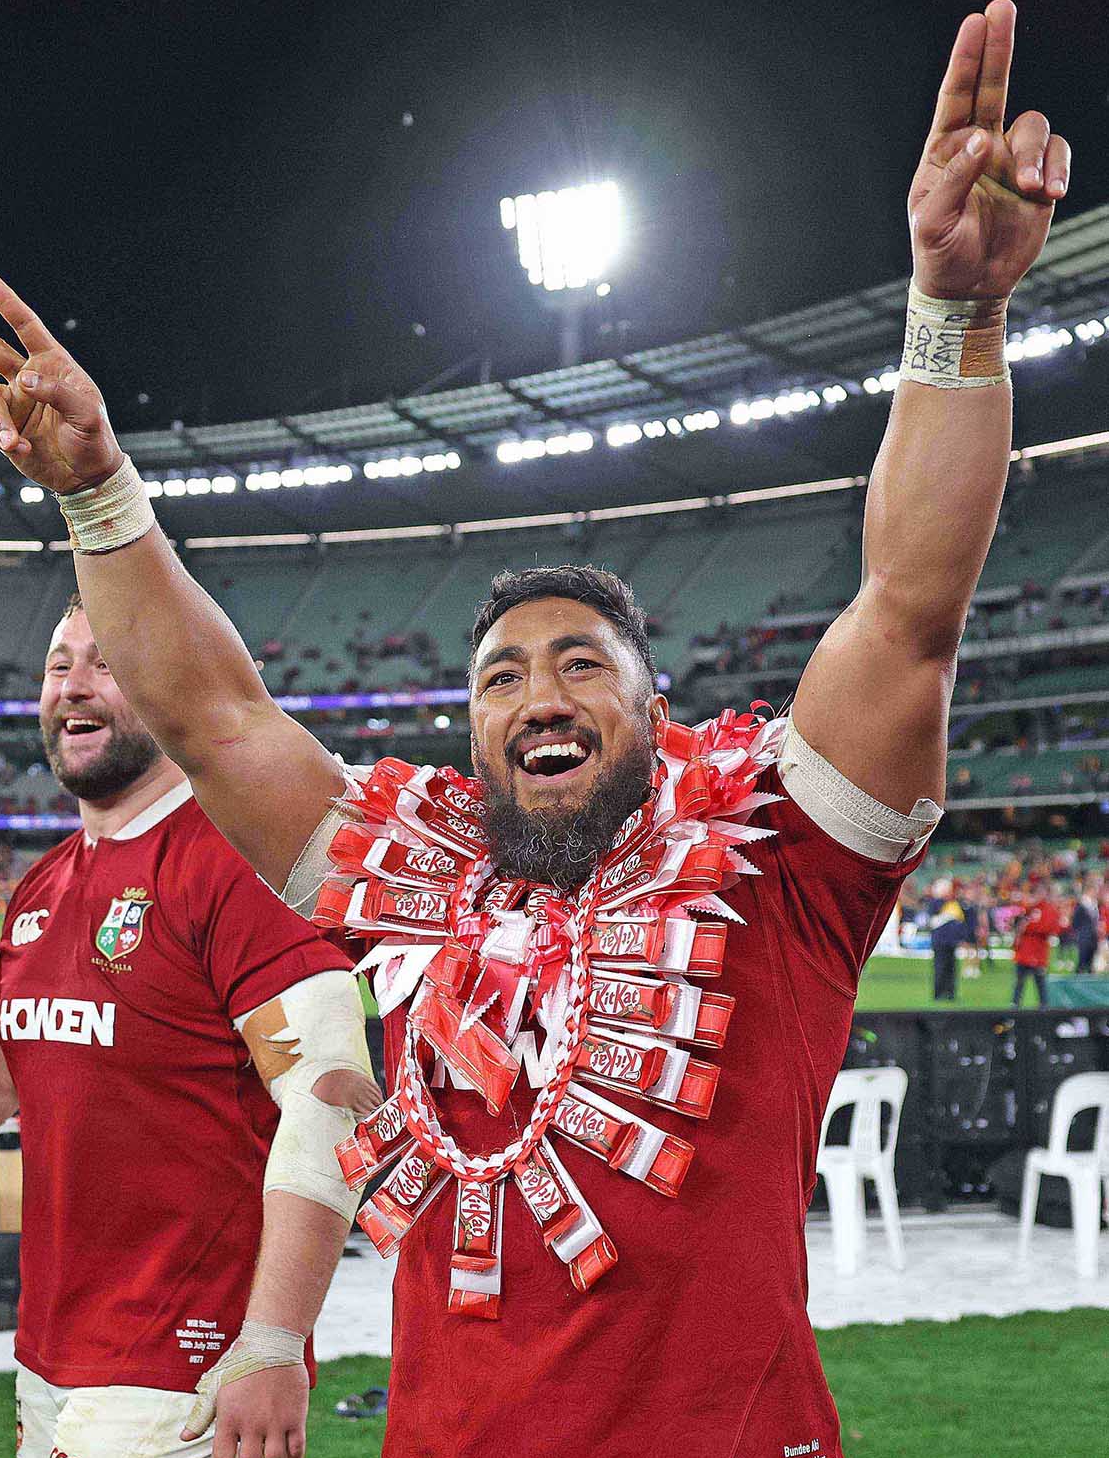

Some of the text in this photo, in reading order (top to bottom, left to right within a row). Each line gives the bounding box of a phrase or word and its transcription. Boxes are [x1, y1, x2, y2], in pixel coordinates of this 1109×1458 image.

[911, 324, 932, 370] DAD
[410, 851, 454, 871] KitKat
[398, 893, 442, 918] KitKat
[601, 925, 642, 955] KitKat
[594, 983, 640, 1013] KitKat
[0, 997, 116, 1047] HOWDEN
[592, 1045, 639, 1077] KitKat
[557, 1102, 606, 1135] KitKat
[396, 1157, 425, 1204] KitKat
[523, 1172, 560, 1211] KitKat
[460, 1187, 491, 1235] KitKat
[783, 1443, 811, 1458] Bundee
